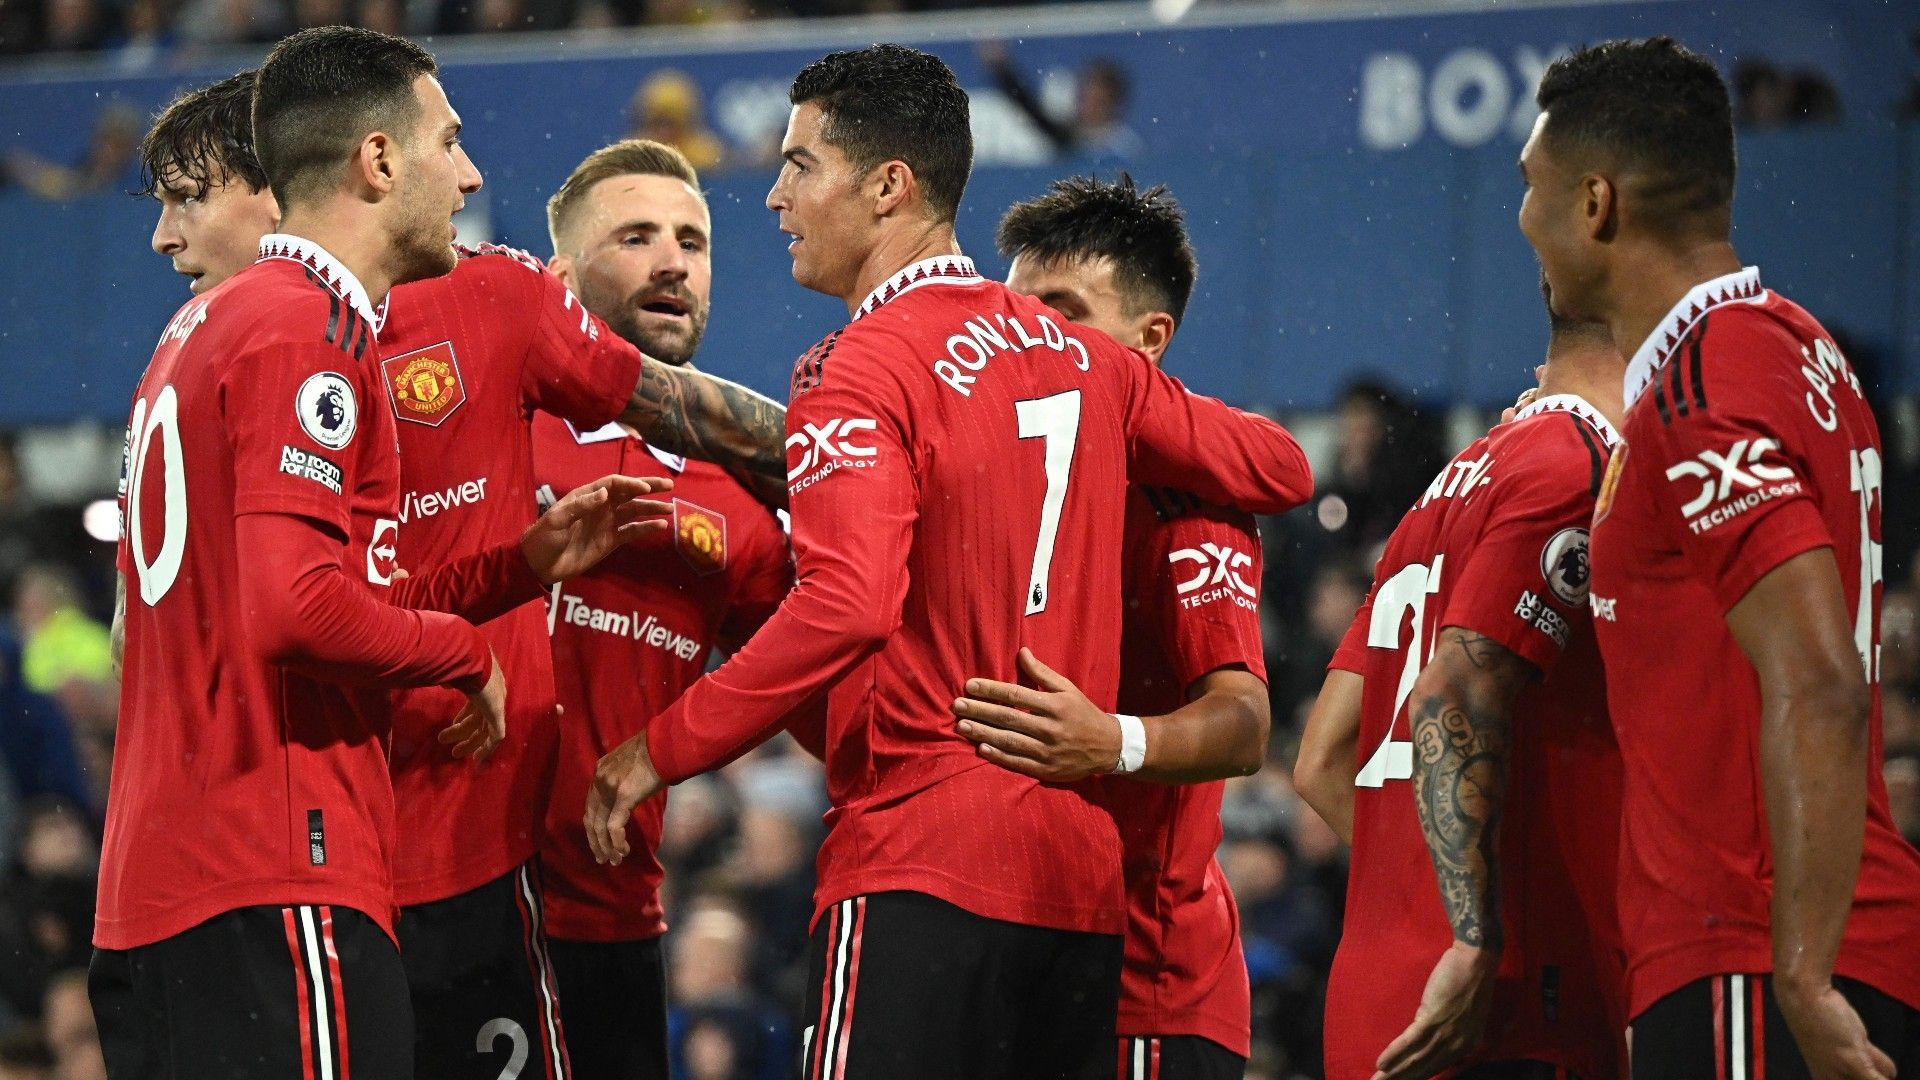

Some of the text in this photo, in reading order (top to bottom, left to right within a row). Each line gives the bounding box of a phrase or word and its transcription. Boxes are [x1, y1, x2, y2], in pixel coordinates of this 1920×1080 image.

[400, 361, 445, 384] MANCHESTER
[933, 313, 1090, 397] RONLDO
[415, 396, 447, 410] UNITED
[279, 461, 304, 476] for
[281, 445, 340, 481] No room
[785, 418, 877, 482] DXC
[788, 459, 877, 496] TECHNOLOGY
[1665, 437, 1795, 519] DXC
[1014, 388, 1082, 616] 7
[1689, 481, 1803, 535] TECHNOLOGY
[1168, 542, 1256, 598] DXC
[562, 594, 701, 662] TeamViewer
[1417, 707, 1475, 764] 39
[476, 1017, 529, 1080] 2
